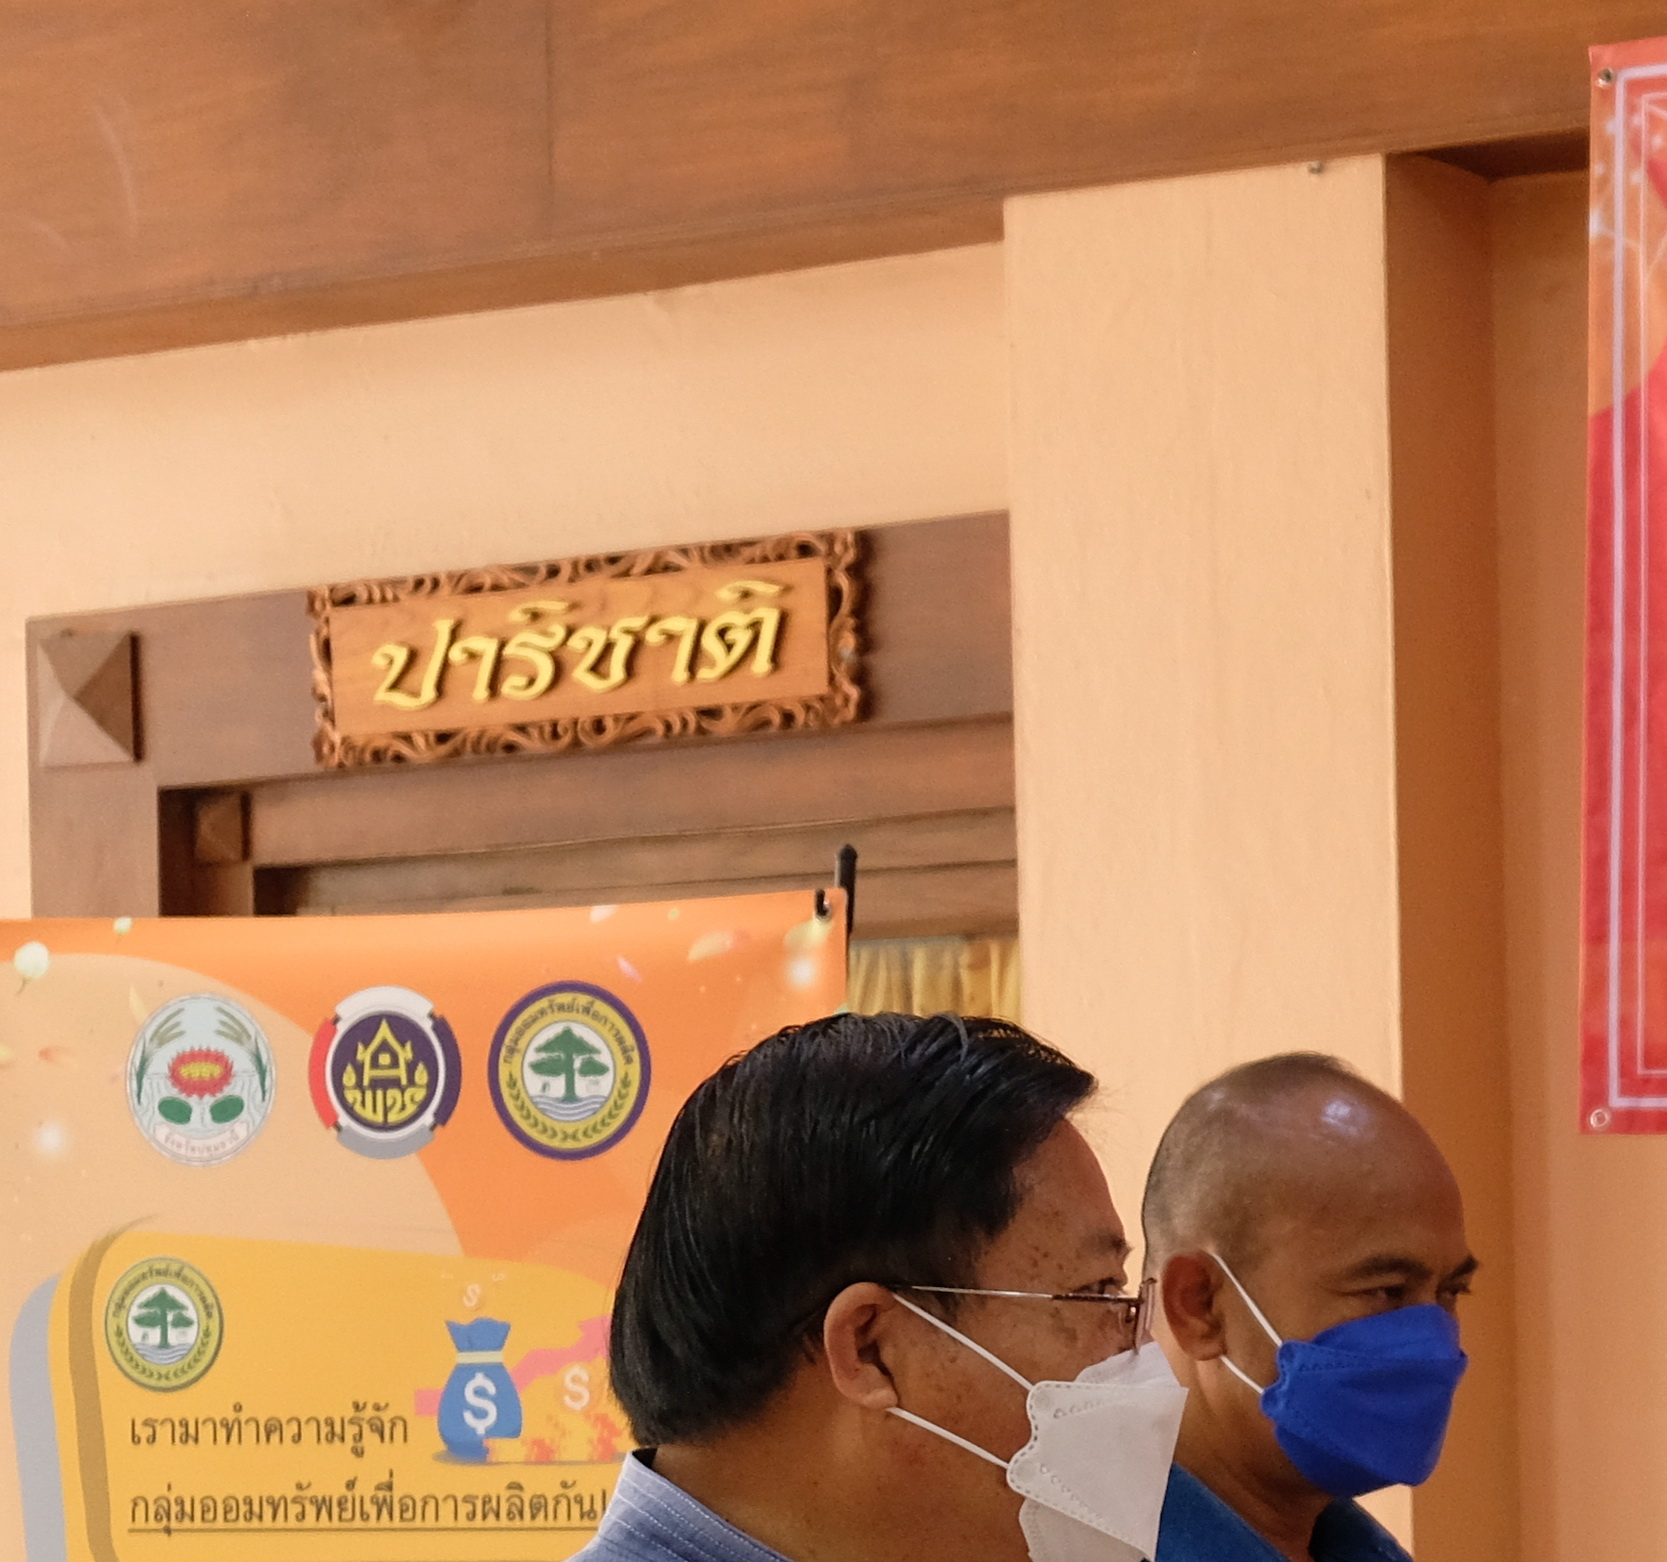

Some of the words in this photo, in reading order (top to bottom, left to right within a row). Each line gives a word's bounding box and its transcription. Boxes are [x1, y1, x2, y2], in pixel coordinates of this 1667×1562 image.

[371, 579, 785, 710] ปาริชาติ
[129, 1401, 409, 1460] เรามาทำความรู้จัก
